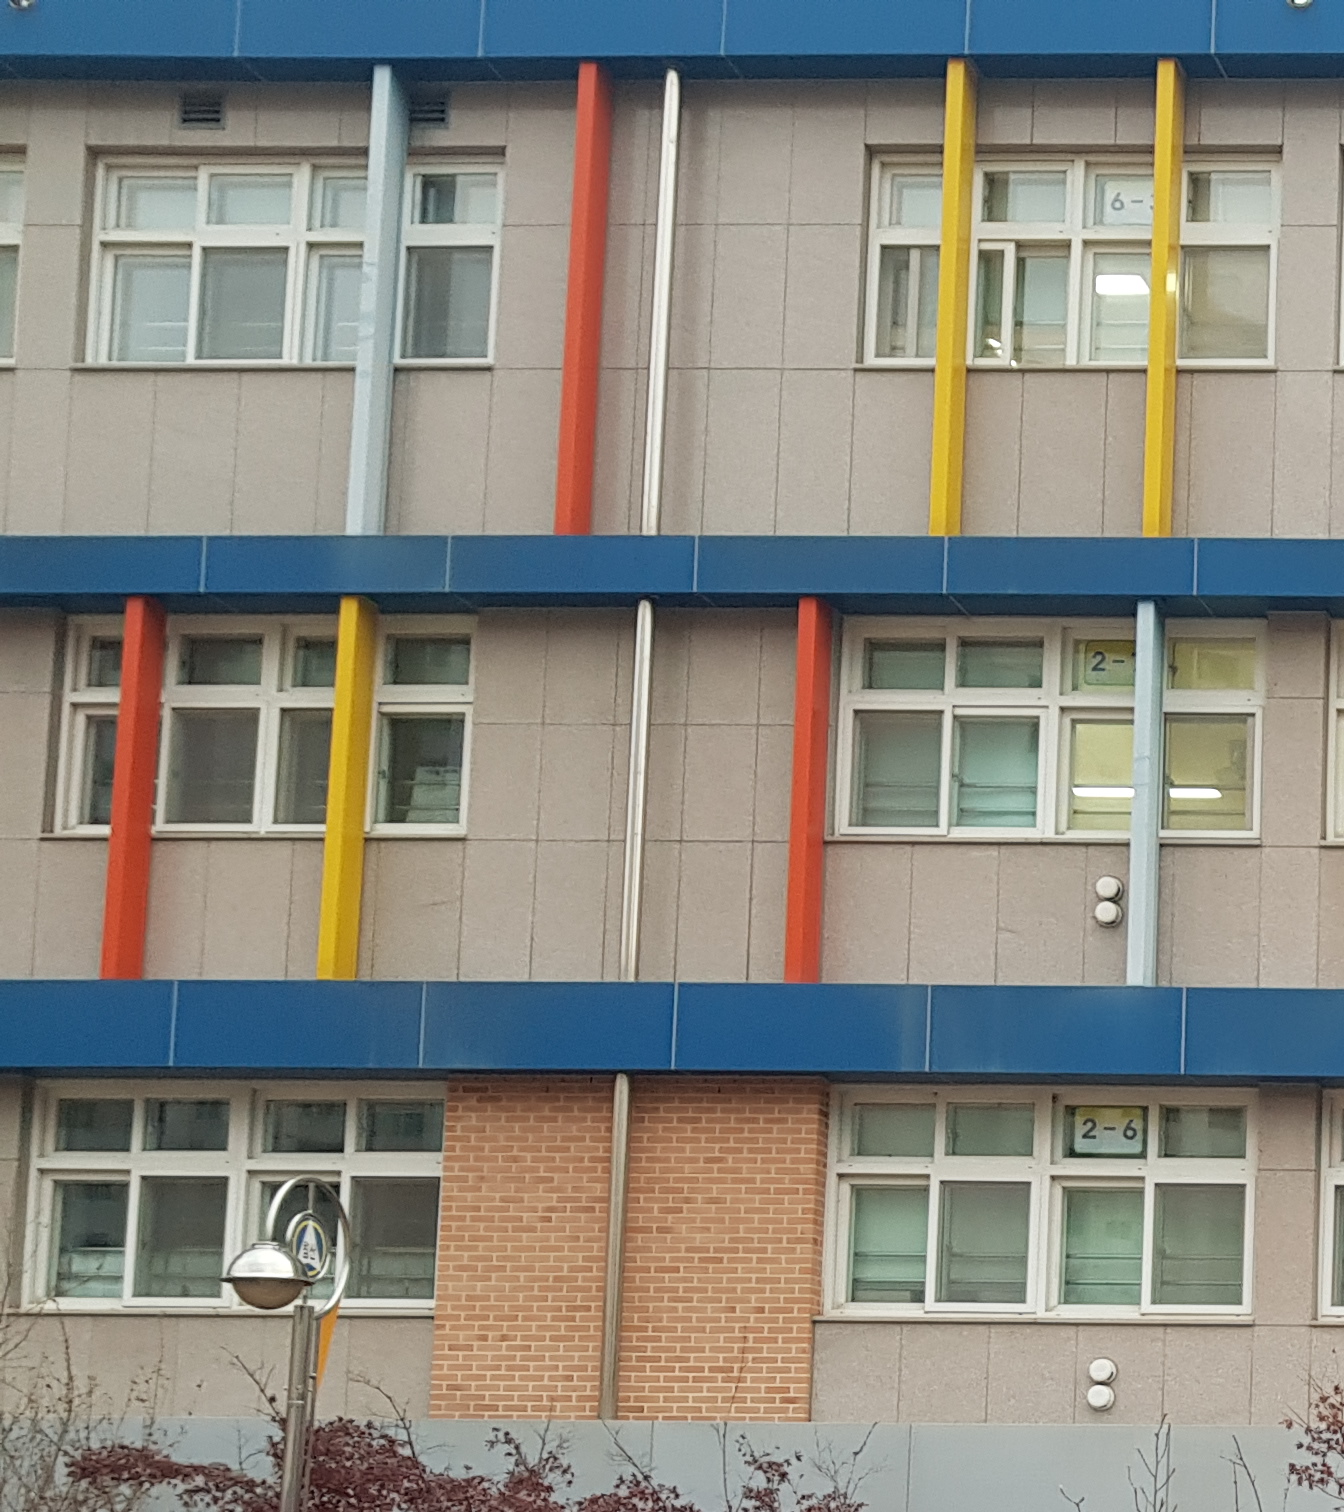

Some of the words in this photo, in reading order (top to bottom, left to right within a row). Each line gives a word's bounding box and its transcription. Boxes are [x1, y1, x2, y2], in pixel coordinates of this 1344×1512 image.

[1111, 192, 1153, 211] 6-
[1091, 651, 1136, 672] 2-
[1081, 1118, 1137, 1140] 2-6
